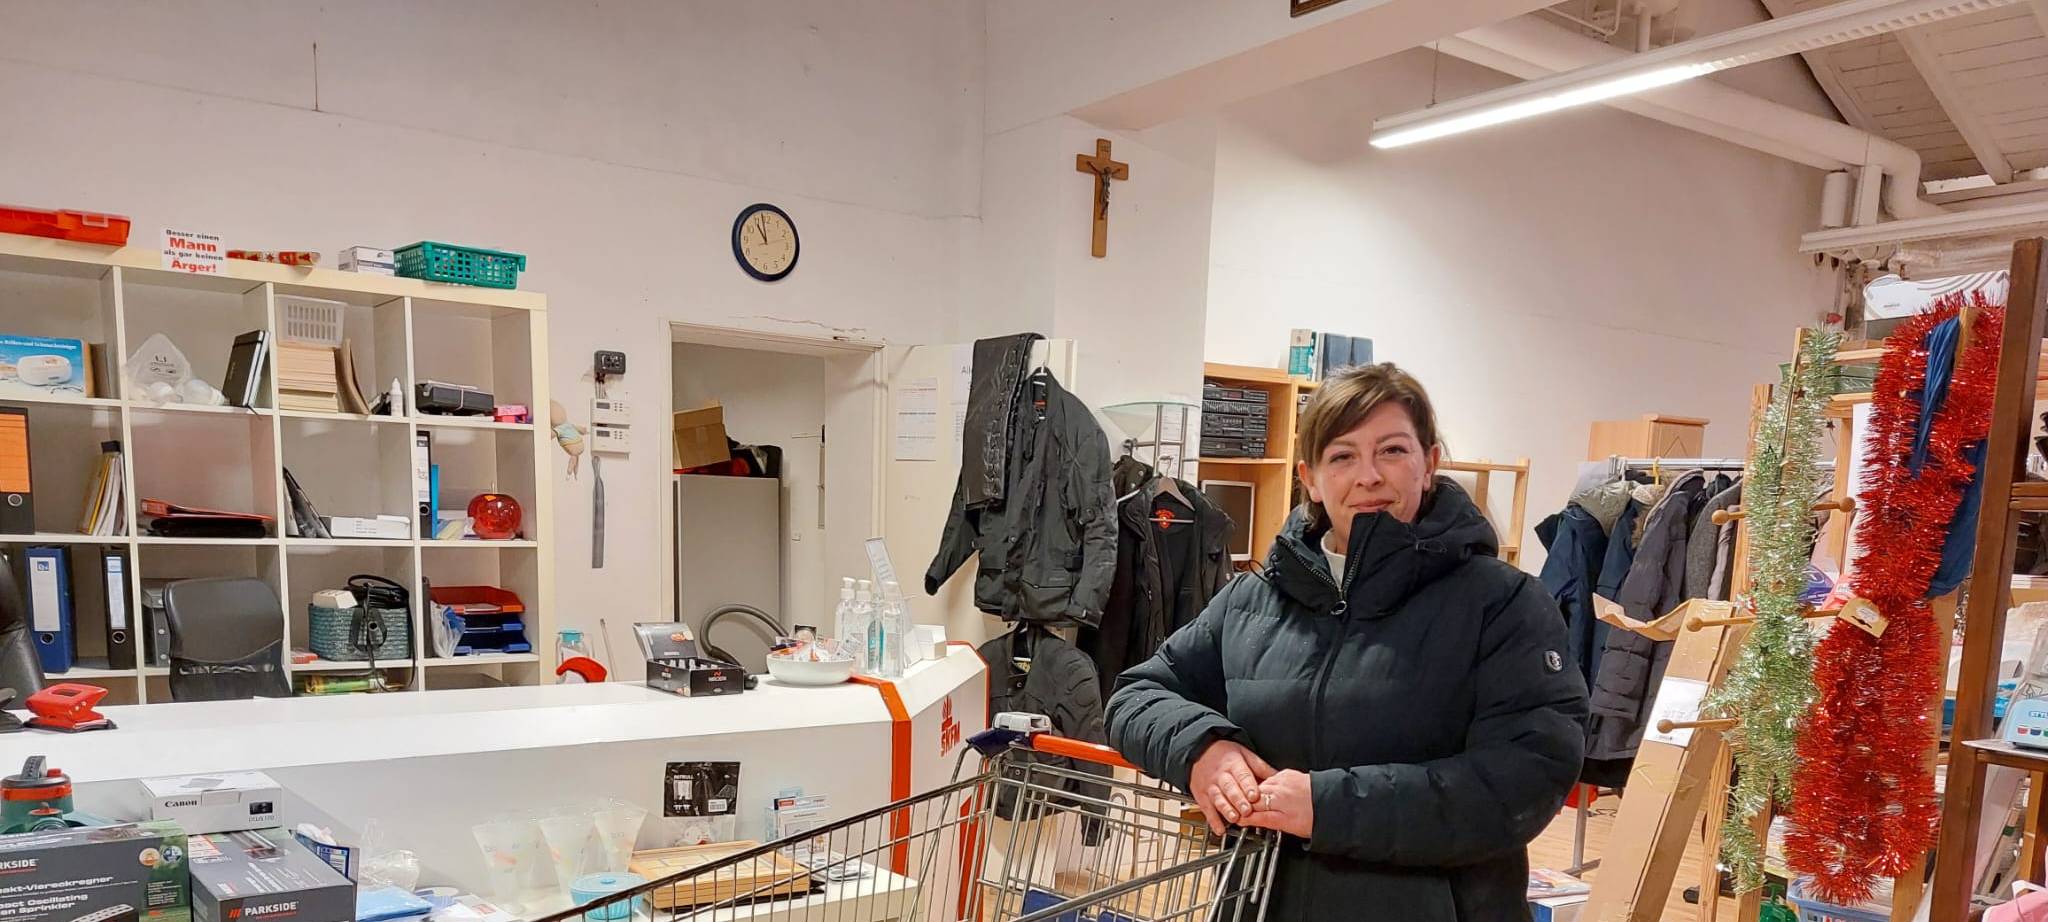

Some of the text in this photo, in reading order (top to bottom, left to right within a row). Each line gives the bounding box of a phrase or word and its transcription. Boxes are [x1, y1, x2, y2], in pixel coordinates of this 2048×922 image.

[166, 229, 193, 237] Besser
[169, 237, 216, 252] Mann
[195, 252, 223, 260] keinen
[171, 258, 216, 272] Ärger!
[941, 720, 961, 758] SKFM
[164, 799, 198, 808] Canon
[27, 894, 88, 906] Oscillating
[19, 902, 76, 914] Sprinkler
[245, 902, 297, 916] PARKSIDE
